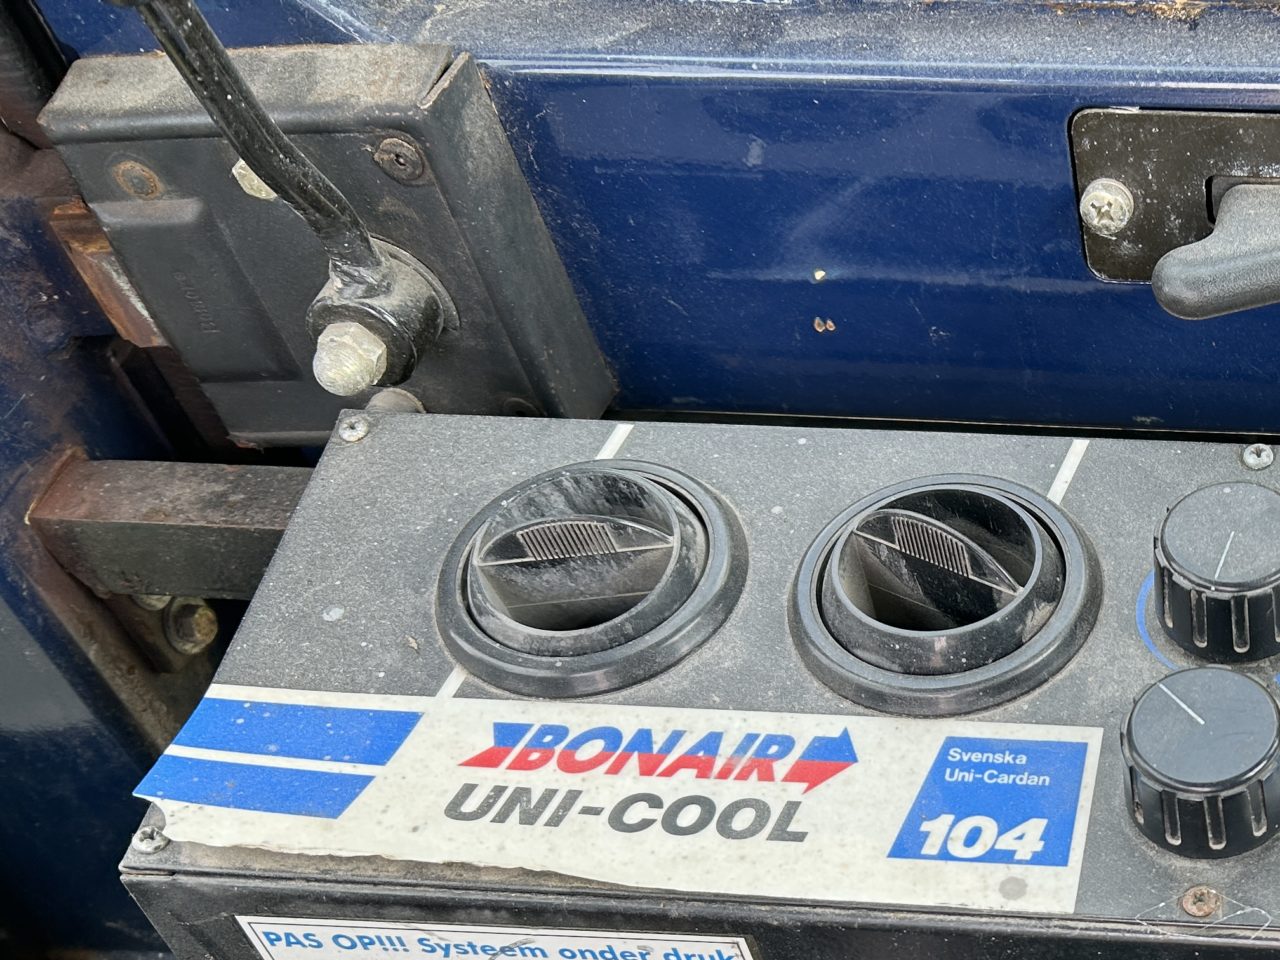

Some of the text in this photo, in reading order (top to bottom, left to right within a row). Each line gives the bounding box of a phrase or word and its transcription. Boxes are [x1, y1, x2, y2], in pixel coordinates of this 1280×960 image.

[519, 727, 798, 783] BONAIR
[946, 746, 1027, 766] Svenska
[944, 768, 1051, 787] Uni-Cardan
[443, 783, 810, 843] UNI-COOL
[918, 814, 1049, 862] 104
[262, 931, 324, 949] PAS
[331, 933, 408, 953] OP!!!
[417, 936, 549, 959] Systeem
